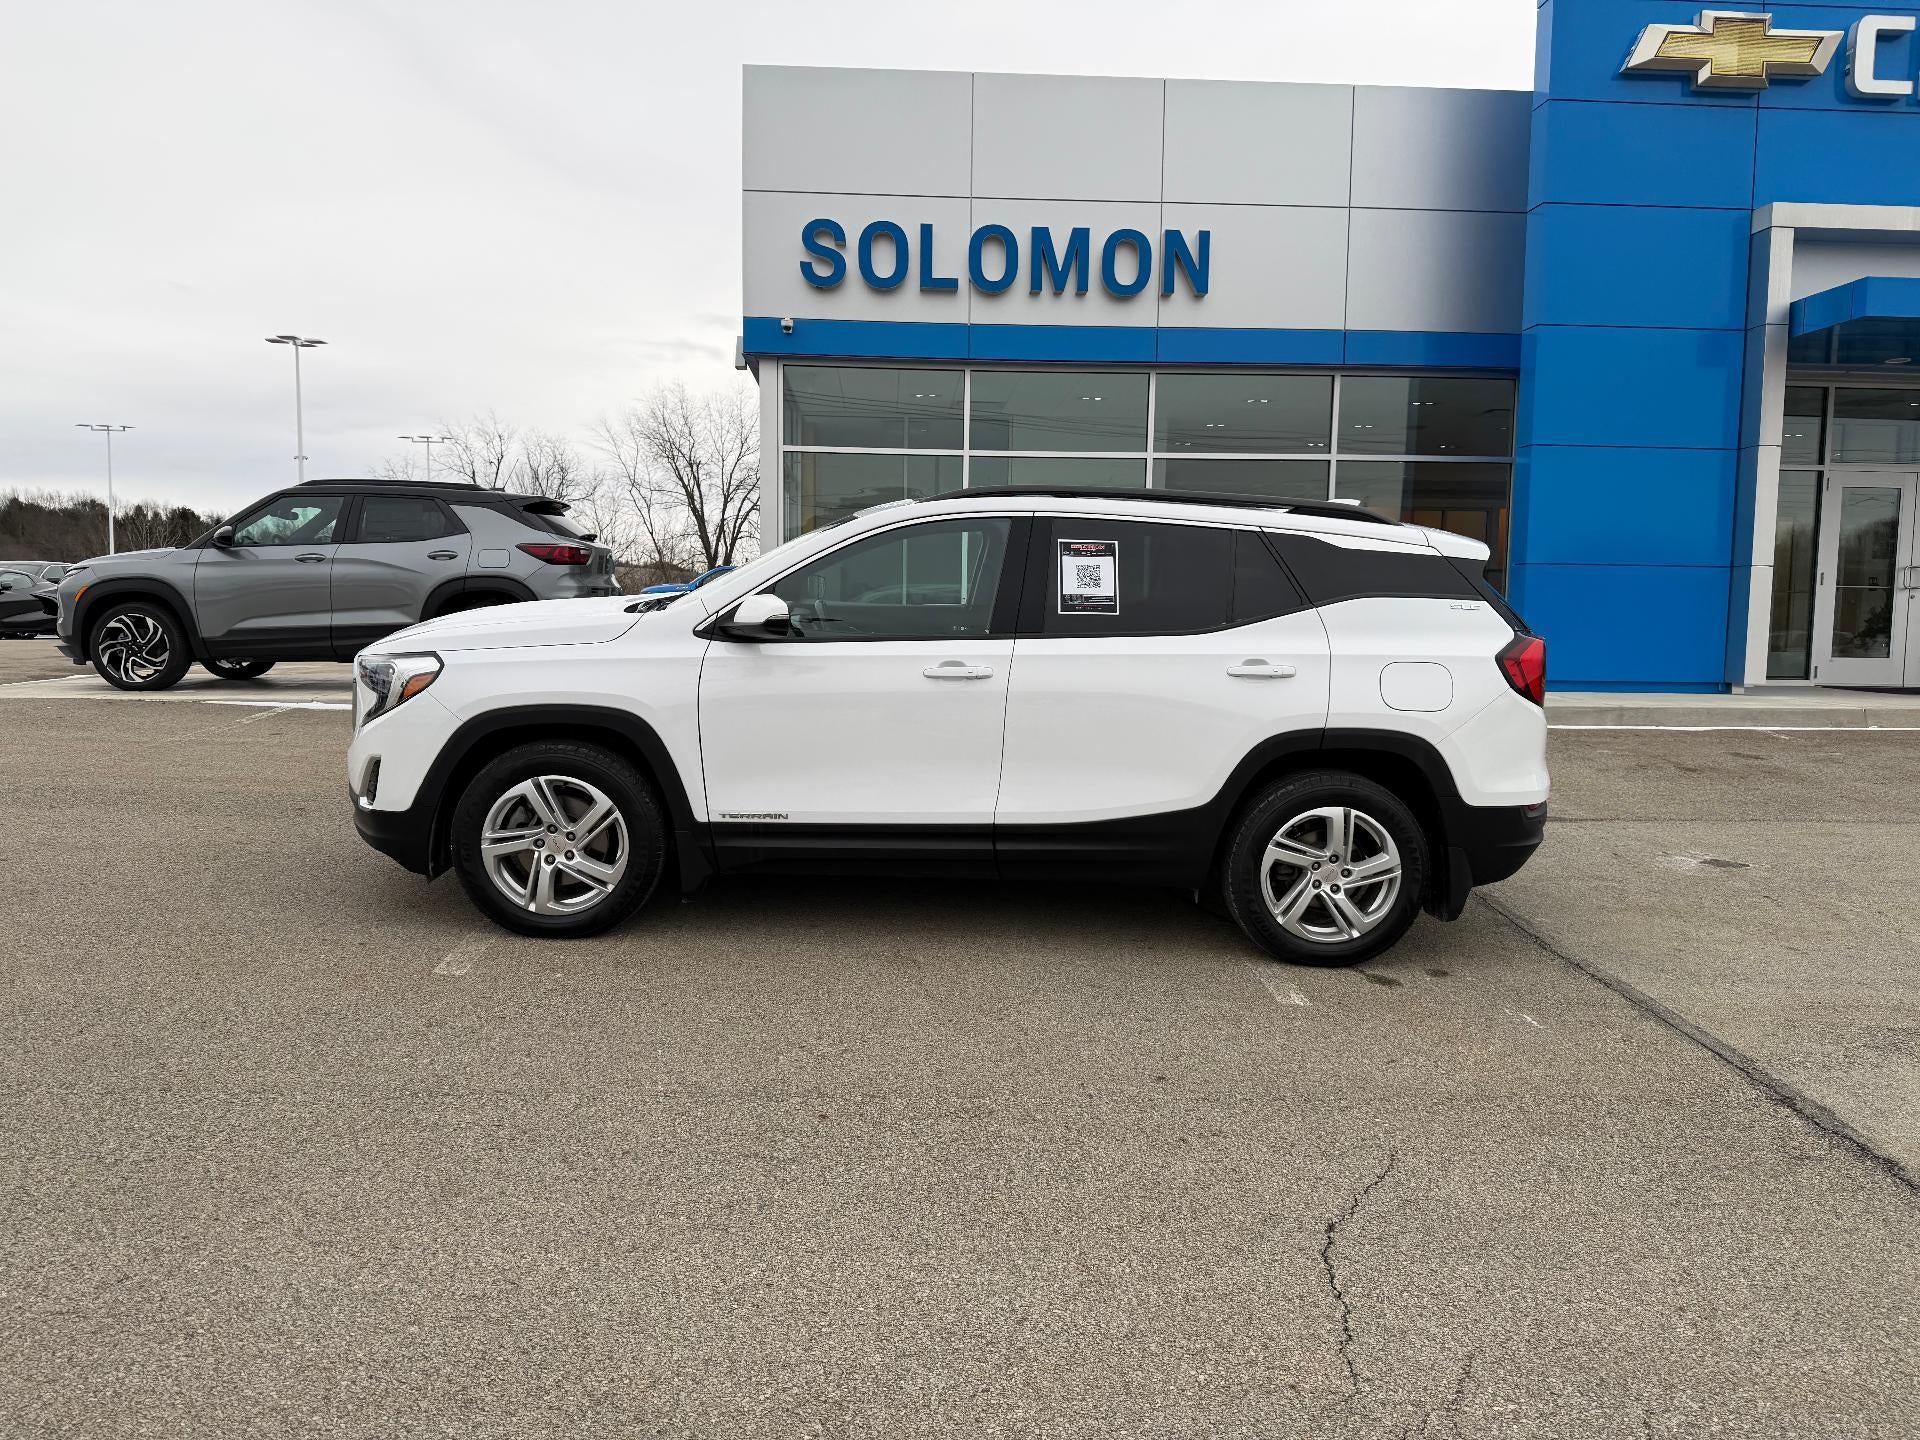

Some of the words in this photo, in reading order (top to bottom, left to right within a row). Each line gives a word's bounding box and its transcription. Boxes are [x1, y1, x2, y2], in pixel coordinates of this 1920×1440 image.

[1848, 14, 1920, 97] C
[799, 217, 1211, 299] SOLOMON
[719, 812, 789, 820] TERRAIN
